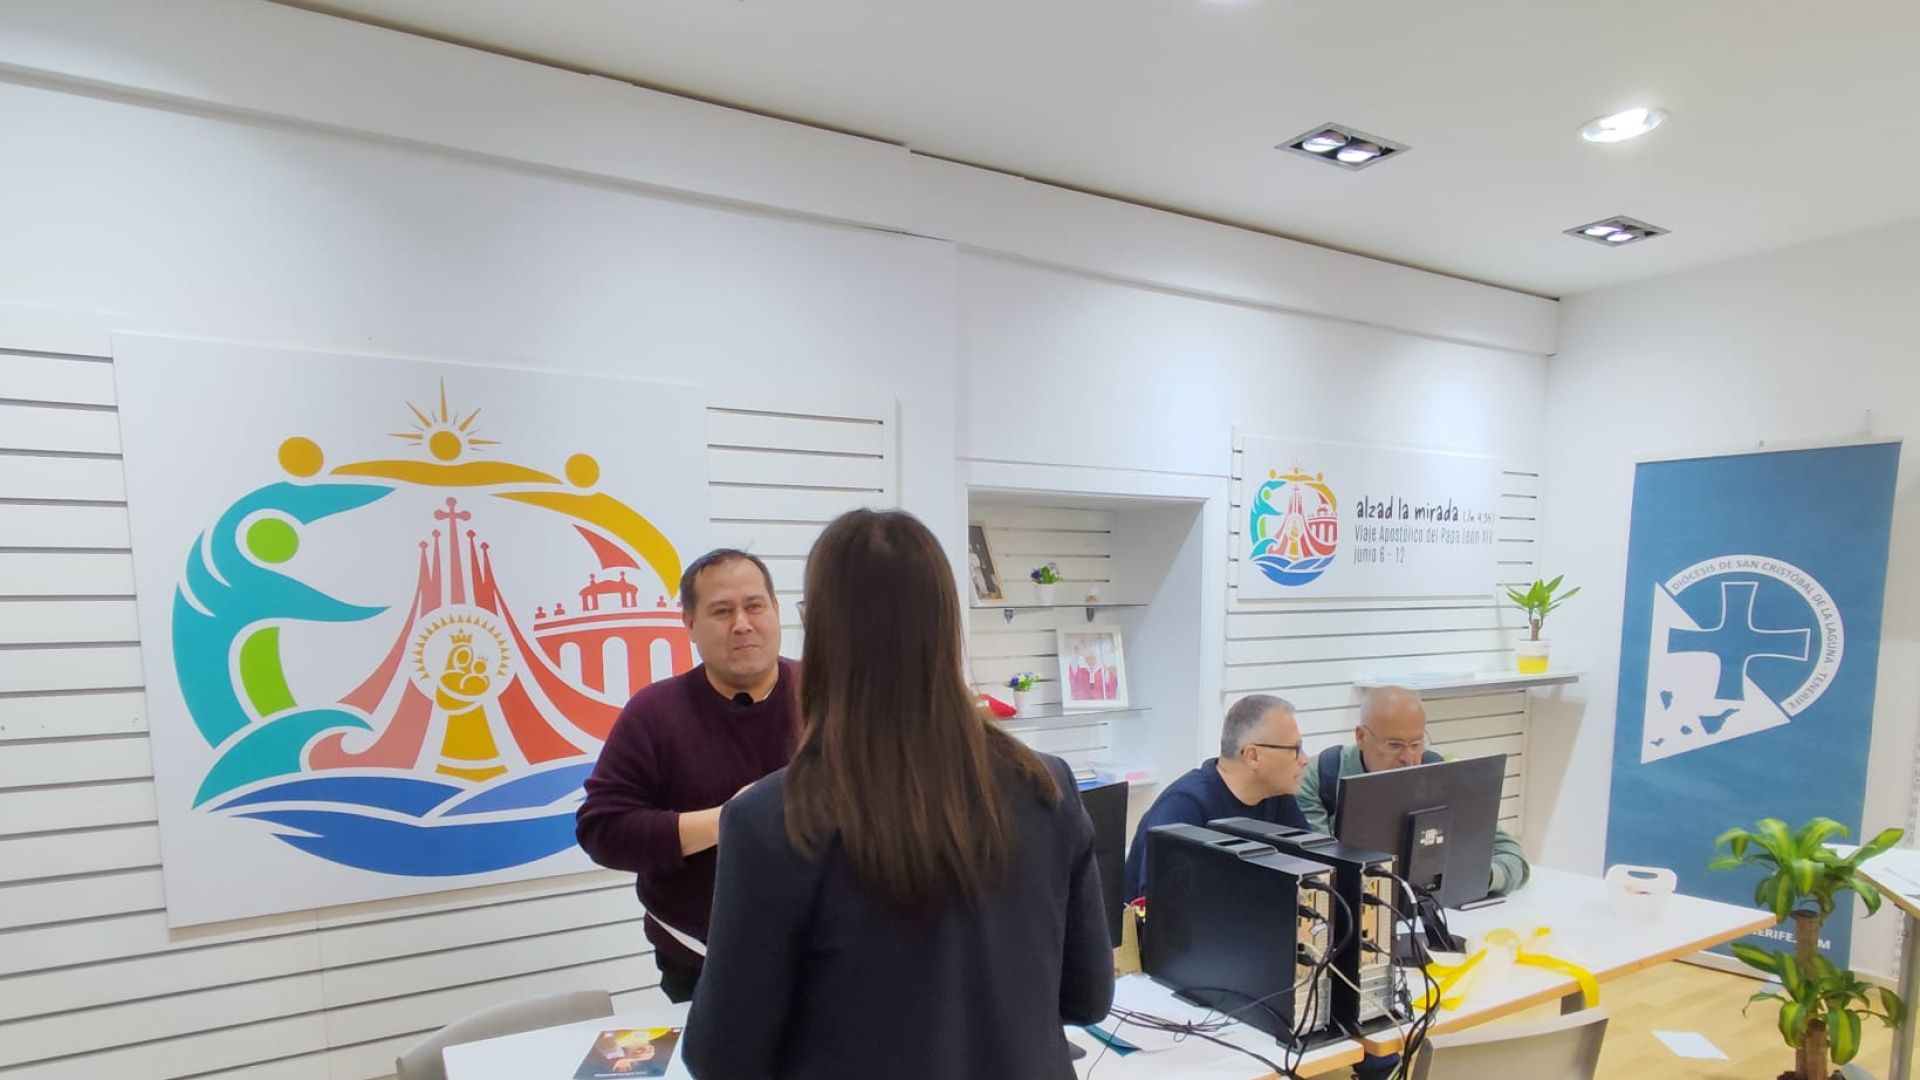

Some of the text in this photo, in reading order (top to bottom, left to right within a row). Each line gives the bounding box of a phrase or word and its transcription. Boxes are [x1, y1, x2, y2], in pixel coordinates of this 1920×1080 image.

[1356, 495, 1393, 519] alzad
[1398, 497, 1409, 520] la
[1414, 498, 1458, 522] mirada
[1354, 524, 1376, 544] Viaje
[1426, 526, 1438, 543] del
[1441, 527, 1460, 546] Papa
[1353, 546, 1376, 565] junio
[1379, 546, 1385, 563] 6
[1396, 546, 1405, 563] 12
[1719, 561, 1733, 569] DE
[1735, 560, 1759, 569] SAN
[1811, 593, 1827, 608] DE
[1821, 607, 1833, 621] LA
[1823, 622, 1837, 664] LAGUNA
[1788, 671, 1828, 710] TENERIFE
